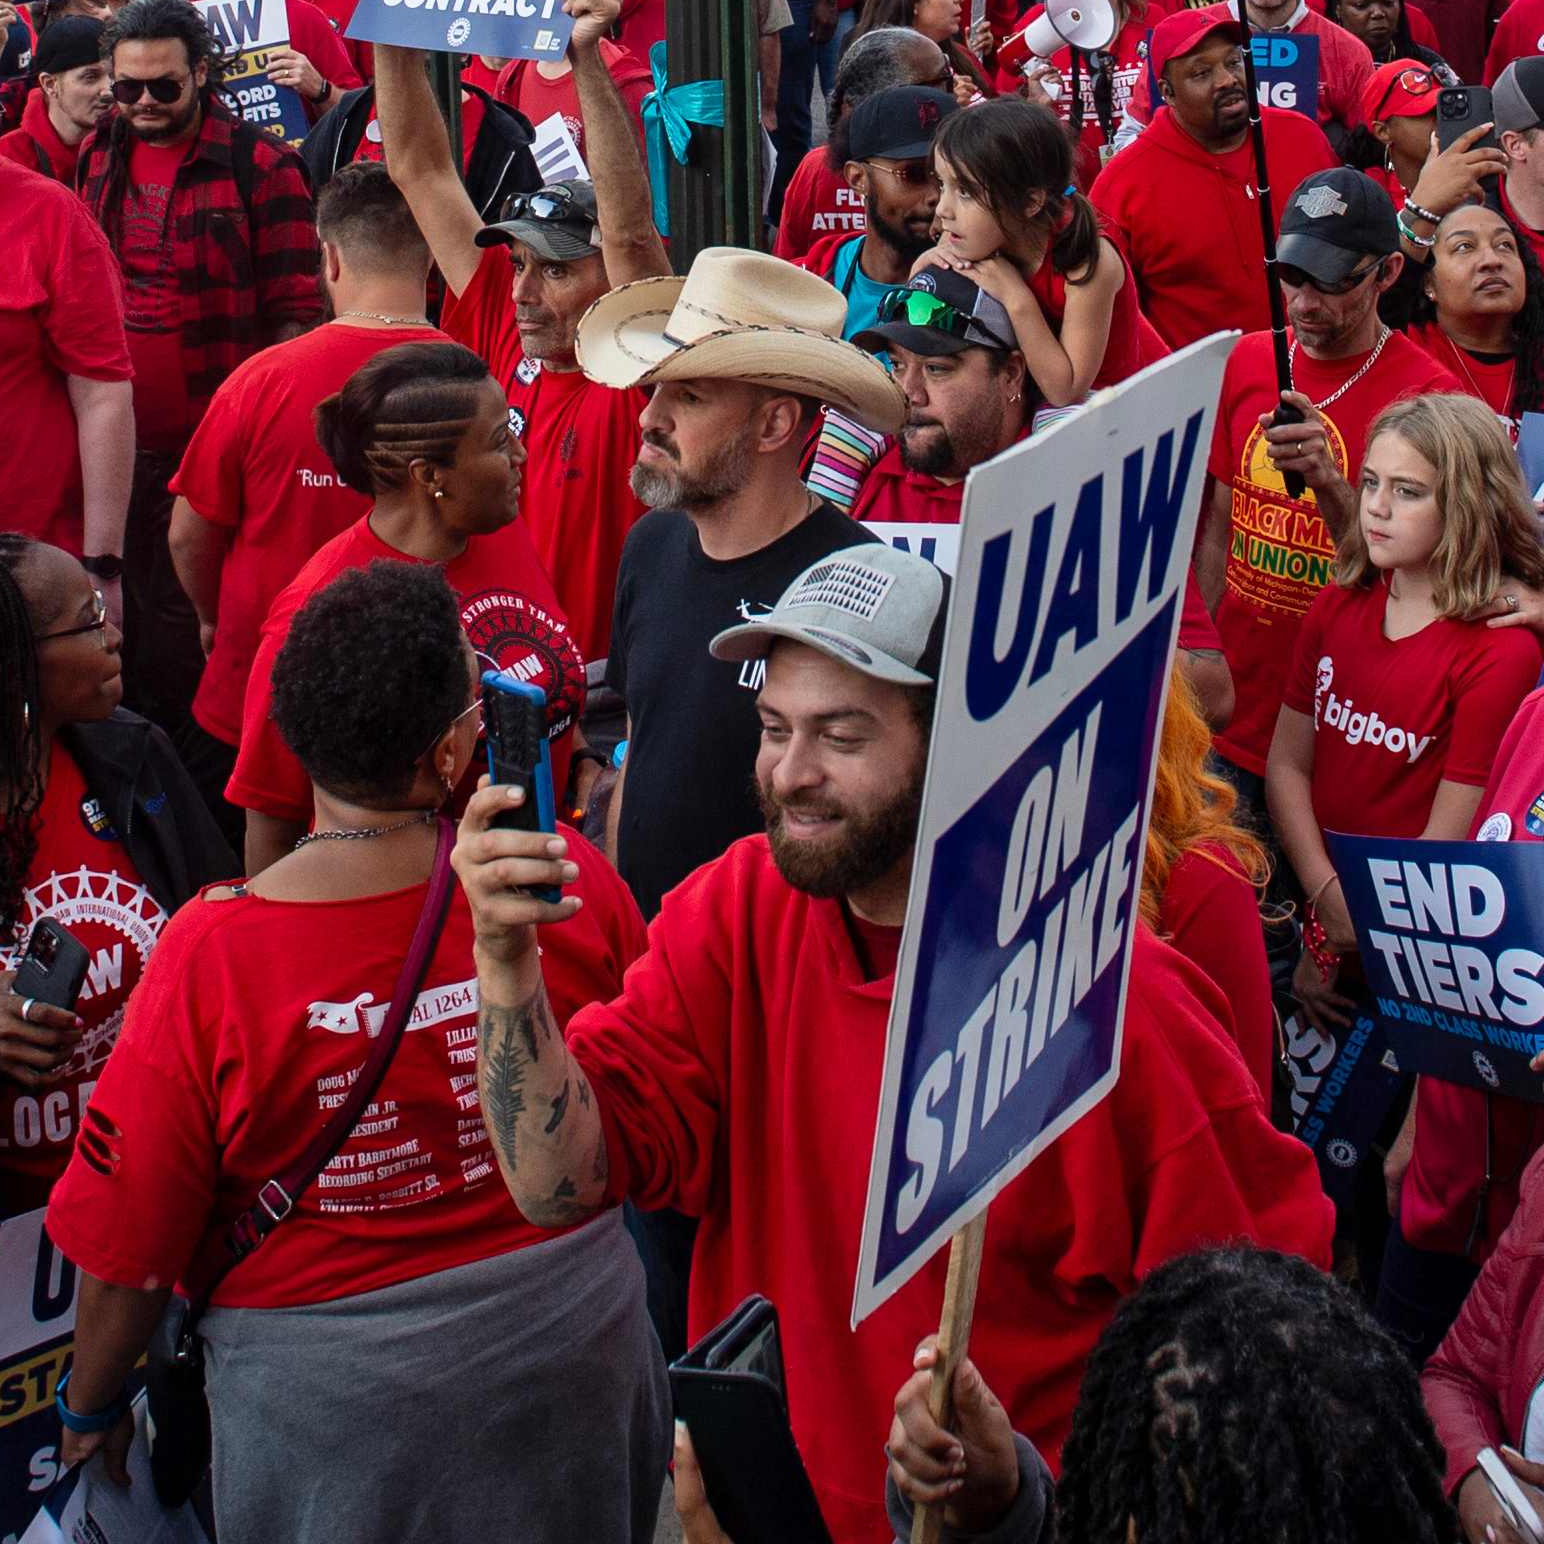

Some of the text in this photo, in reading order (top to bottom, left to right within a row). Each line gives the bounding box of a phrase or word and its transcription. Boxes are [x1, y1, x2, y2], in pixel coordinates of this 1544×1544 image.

[1232, 488, 1291, 542] BLACK
[965, 410, 1202, 723] UAW
[462, 595, 524, 624] STRONGER
[549, 715, 571, 738] 1264
[1324, 693, 1429, 763] bigboy
[997, 701, 1102, 947] ON
[76, 903, 129, 927] INTERNATIONAL
[1368, 858, 1505, 938] END
[434, 987, 472, 1013] 1264
[896, 804, 1138, 1235] STRIKE
[317, 1074, 345, 1092] DOUG
[318, 1152, 433, 1188] RECORDING SECRETARY
